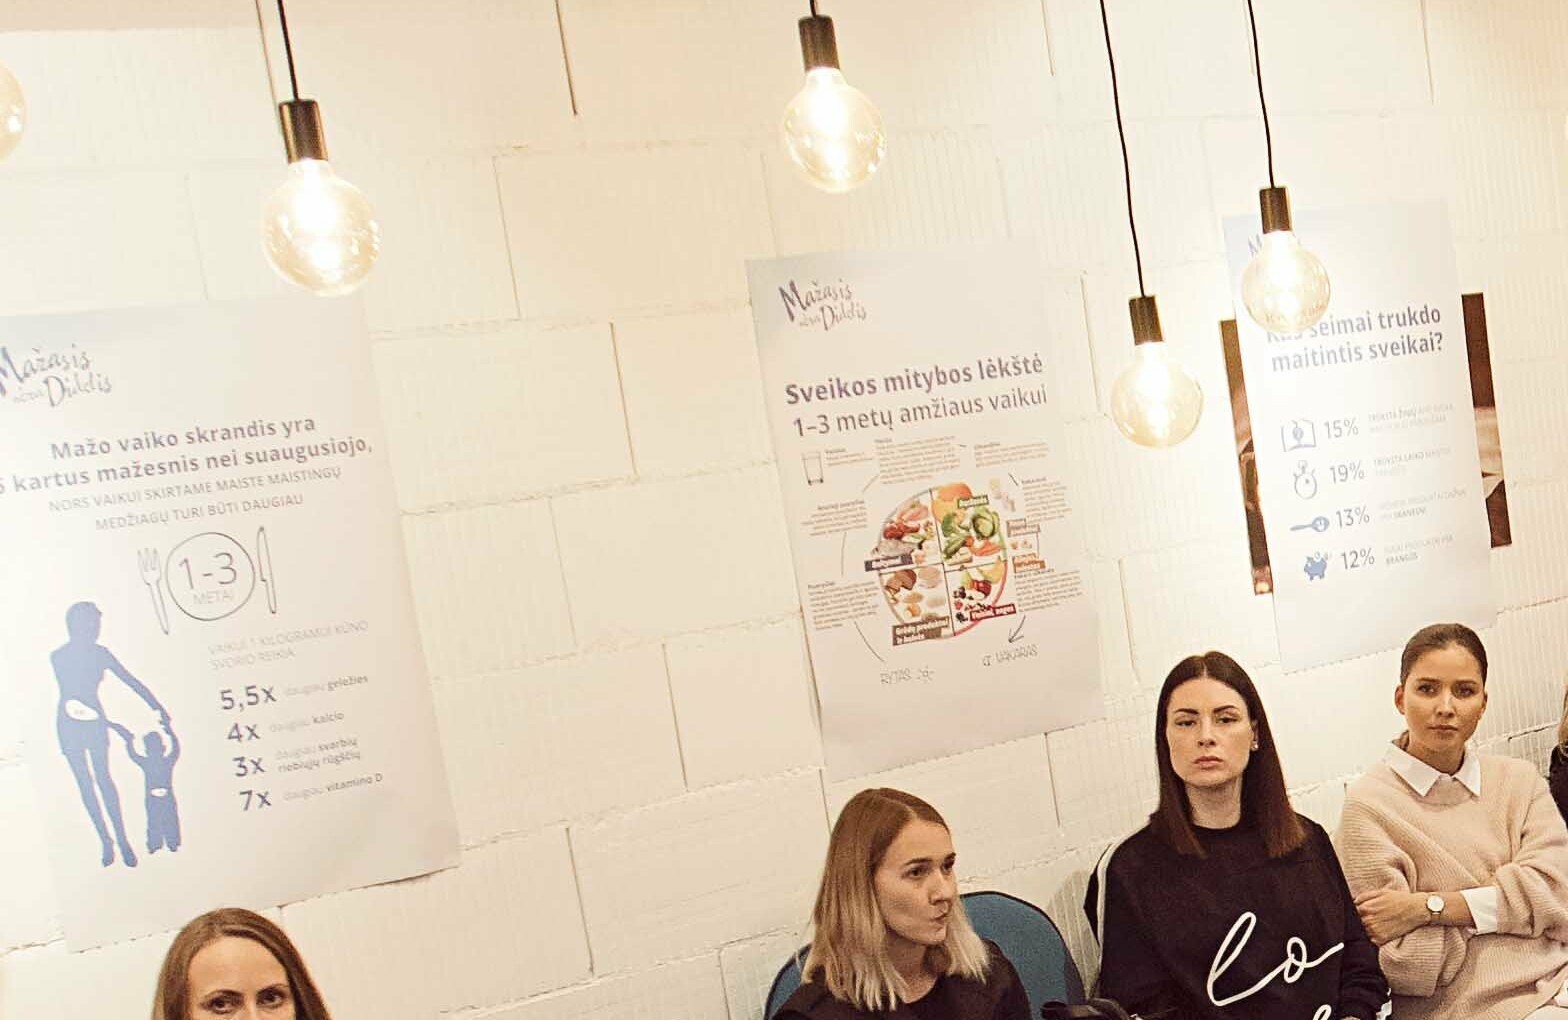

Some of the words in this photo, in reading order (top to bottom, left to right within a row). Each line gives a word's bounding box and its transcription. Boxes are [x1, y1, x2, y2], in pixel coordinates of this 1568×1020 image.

[1377, 304, 1442, 330] trukdo
[1272, 341, 1363, 373] maitintis
[1368, 331, 1443, 361] sveikai?
[784, 376, 878, 406] Sveikos
[883, 363, 973, 394] mitybos
[977, 352, 1044, 381] lėkštė
[835, 406, 895, 432] metų
[898, 395, 983, 424] amžiaus
[987, 383, 1048, 412] vaikui
[50, 438, 112, 460] Mažo
[117, 430, 180, 453] vaiko
[184, 418, 278, 446] skrandis
[280, 417, 317, 440] yra
[1323, 416, 1360, 440] 15%
[12, 470, 91, 493] kartus
[96, 454, 201, 482] mažesnis
[205, 449, 240, 470] nei
[244, 436, 374, 465] suaugusiojo,
[1329, 460, 1365, 484] 19%
[48, 498, 91, 513] NORS
[93, 490, 142, 508] VAIKUI
[144, 481, 212, 502] SKIRTAME
[215, 474, 265, 492] MAISTE
[267, 465, 342, 487] MAISTINGŲ
[95, 513, 170, 532] MEDŽIAGŲ
[172, 507, 205, 522] TURI
[207, 500, 240, 516] BŪTI
[241, 493, 305, 512] DAUGIAU
[1336, 505, 1370, 528] 13%
[178, 550, 239, 592] 1-3
[1341, 547, 1375, 570] 12%
[219, 683, 278, 713] 5,5x
[227, 722, 261, 743] 4x
[232, 755, 267, 778] 3x
[238, 789, 273, 812] 7x
